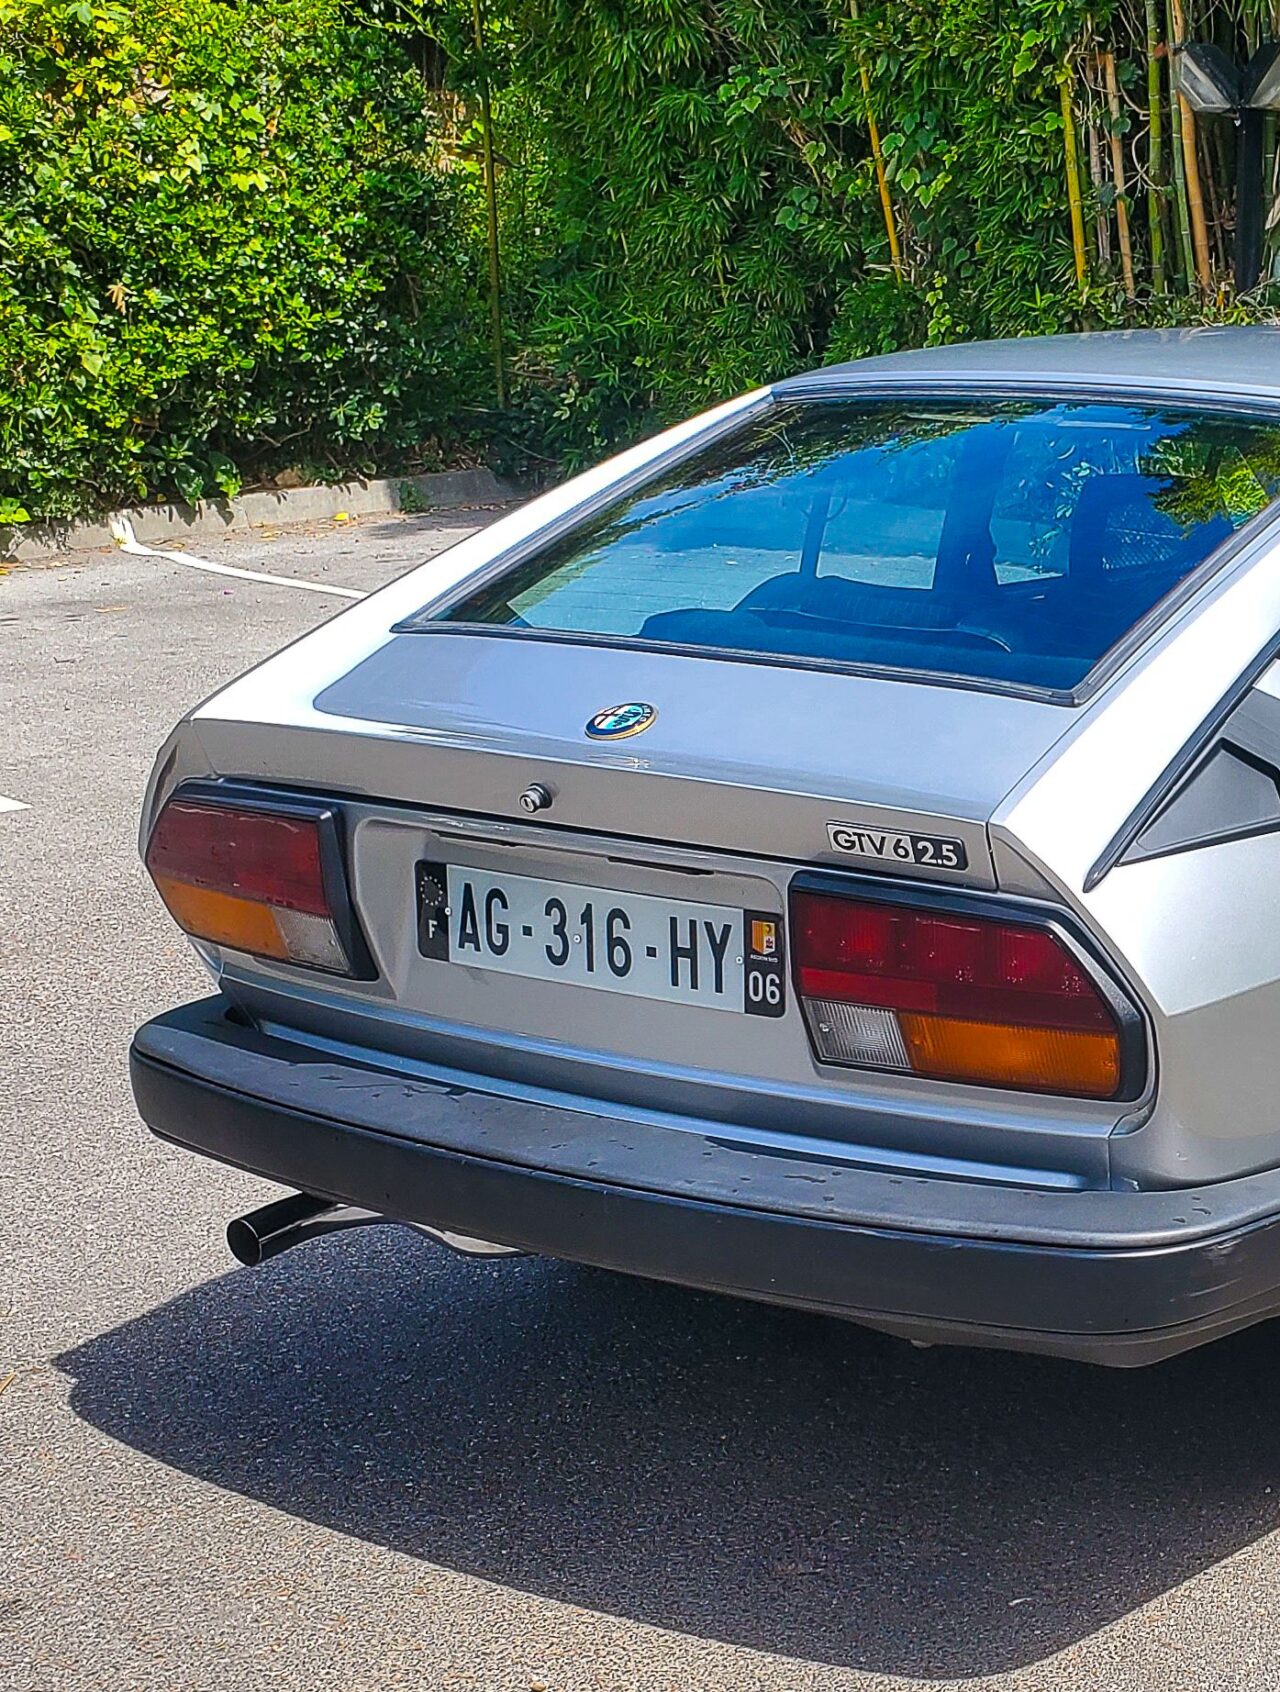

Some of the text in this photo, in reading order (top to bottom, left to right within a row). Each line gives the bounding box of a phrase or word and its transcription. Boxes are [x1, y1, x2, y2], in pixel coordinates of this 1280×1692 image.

[916, 840, 958, 867] 2.5
[428, 919, 438, 939] F
[458, 882, 732, 993] AG-316-HY
[749, 970, 780, 1005] 06
